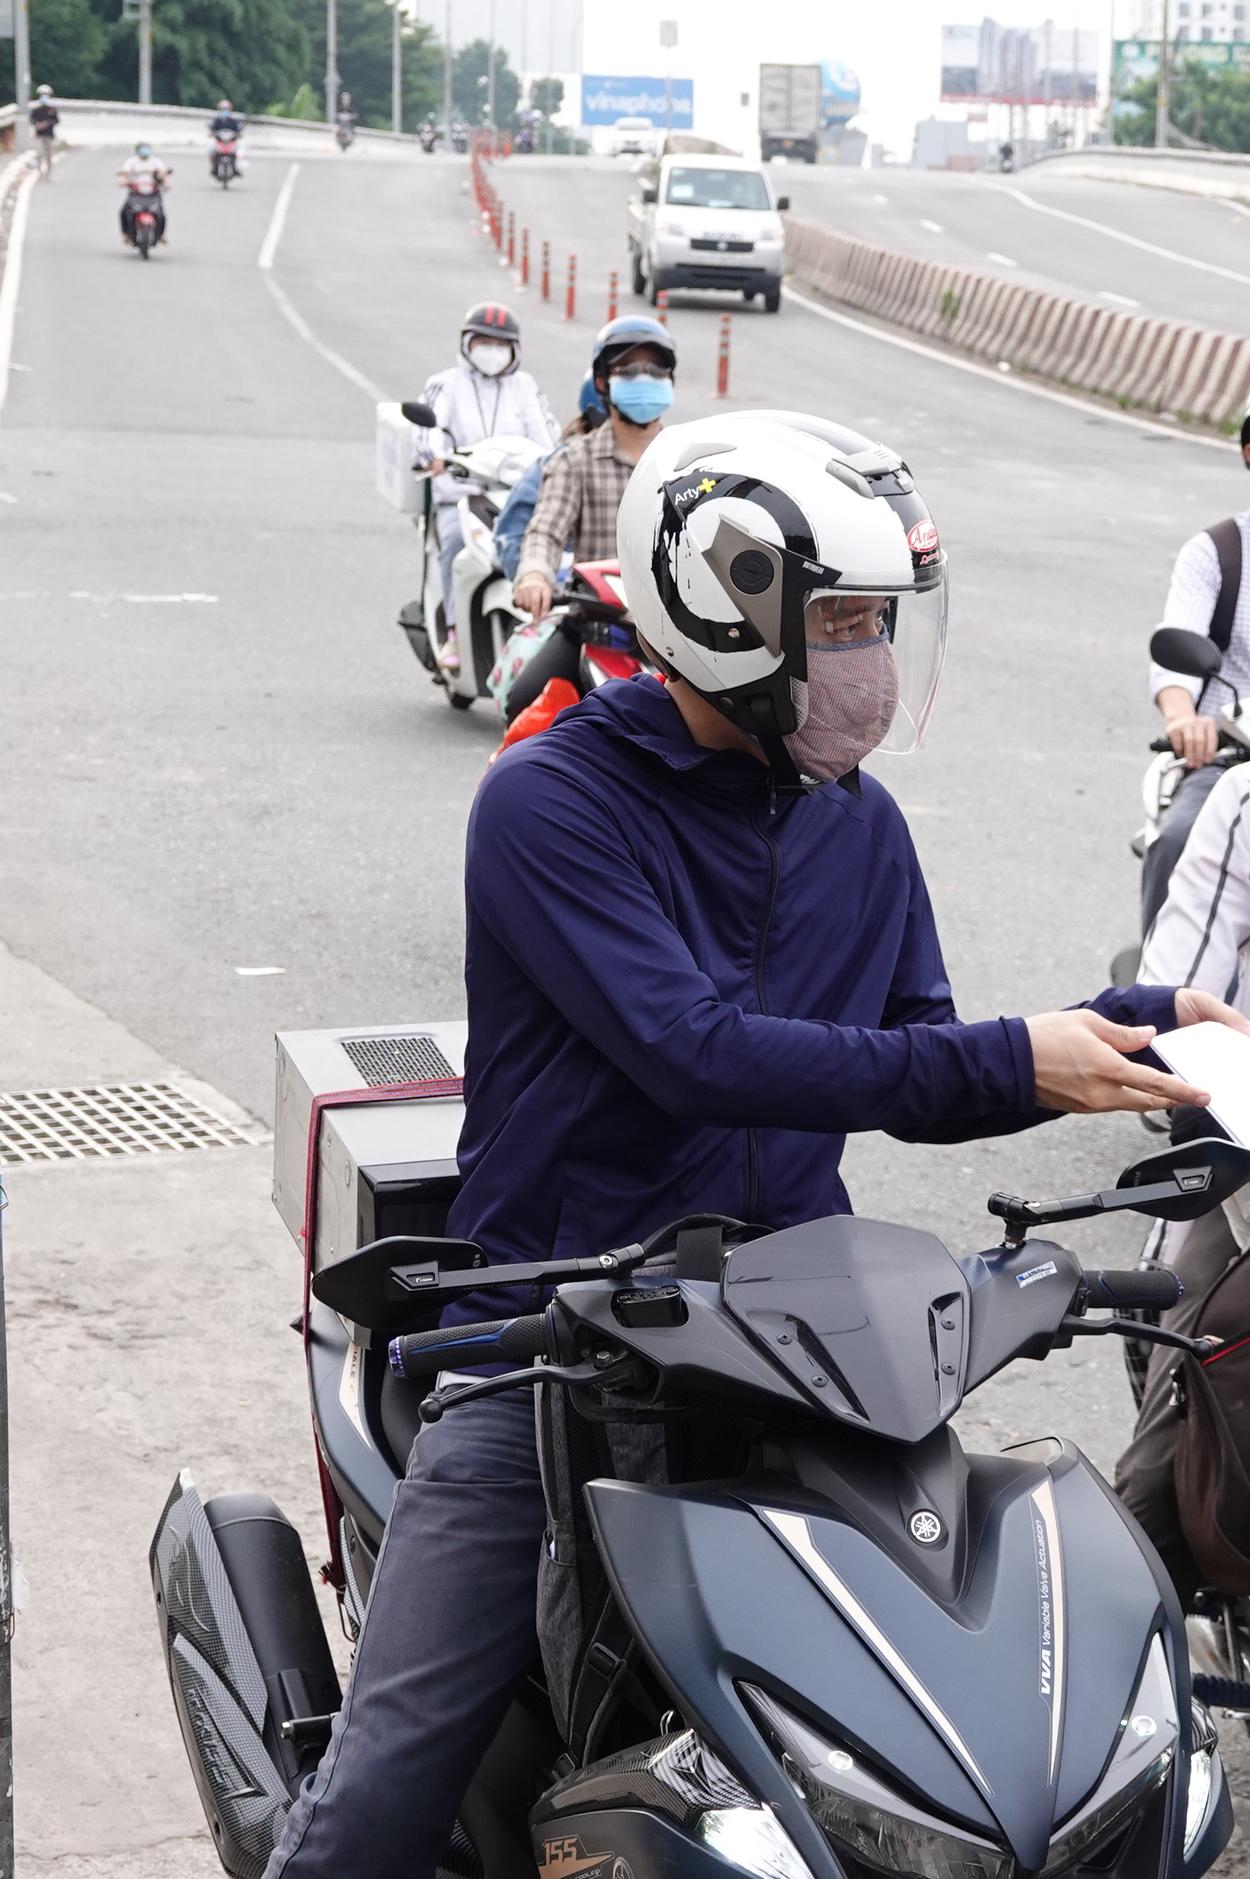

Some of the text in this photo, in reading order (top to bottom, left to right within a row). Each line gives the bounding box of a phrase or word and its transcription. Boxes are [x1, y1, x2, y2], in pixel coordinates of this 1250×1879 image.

[1035, 1519, 1051, 1695] VVA Variable Valve Actuation
[543, 1836, 579, 1865] 155
